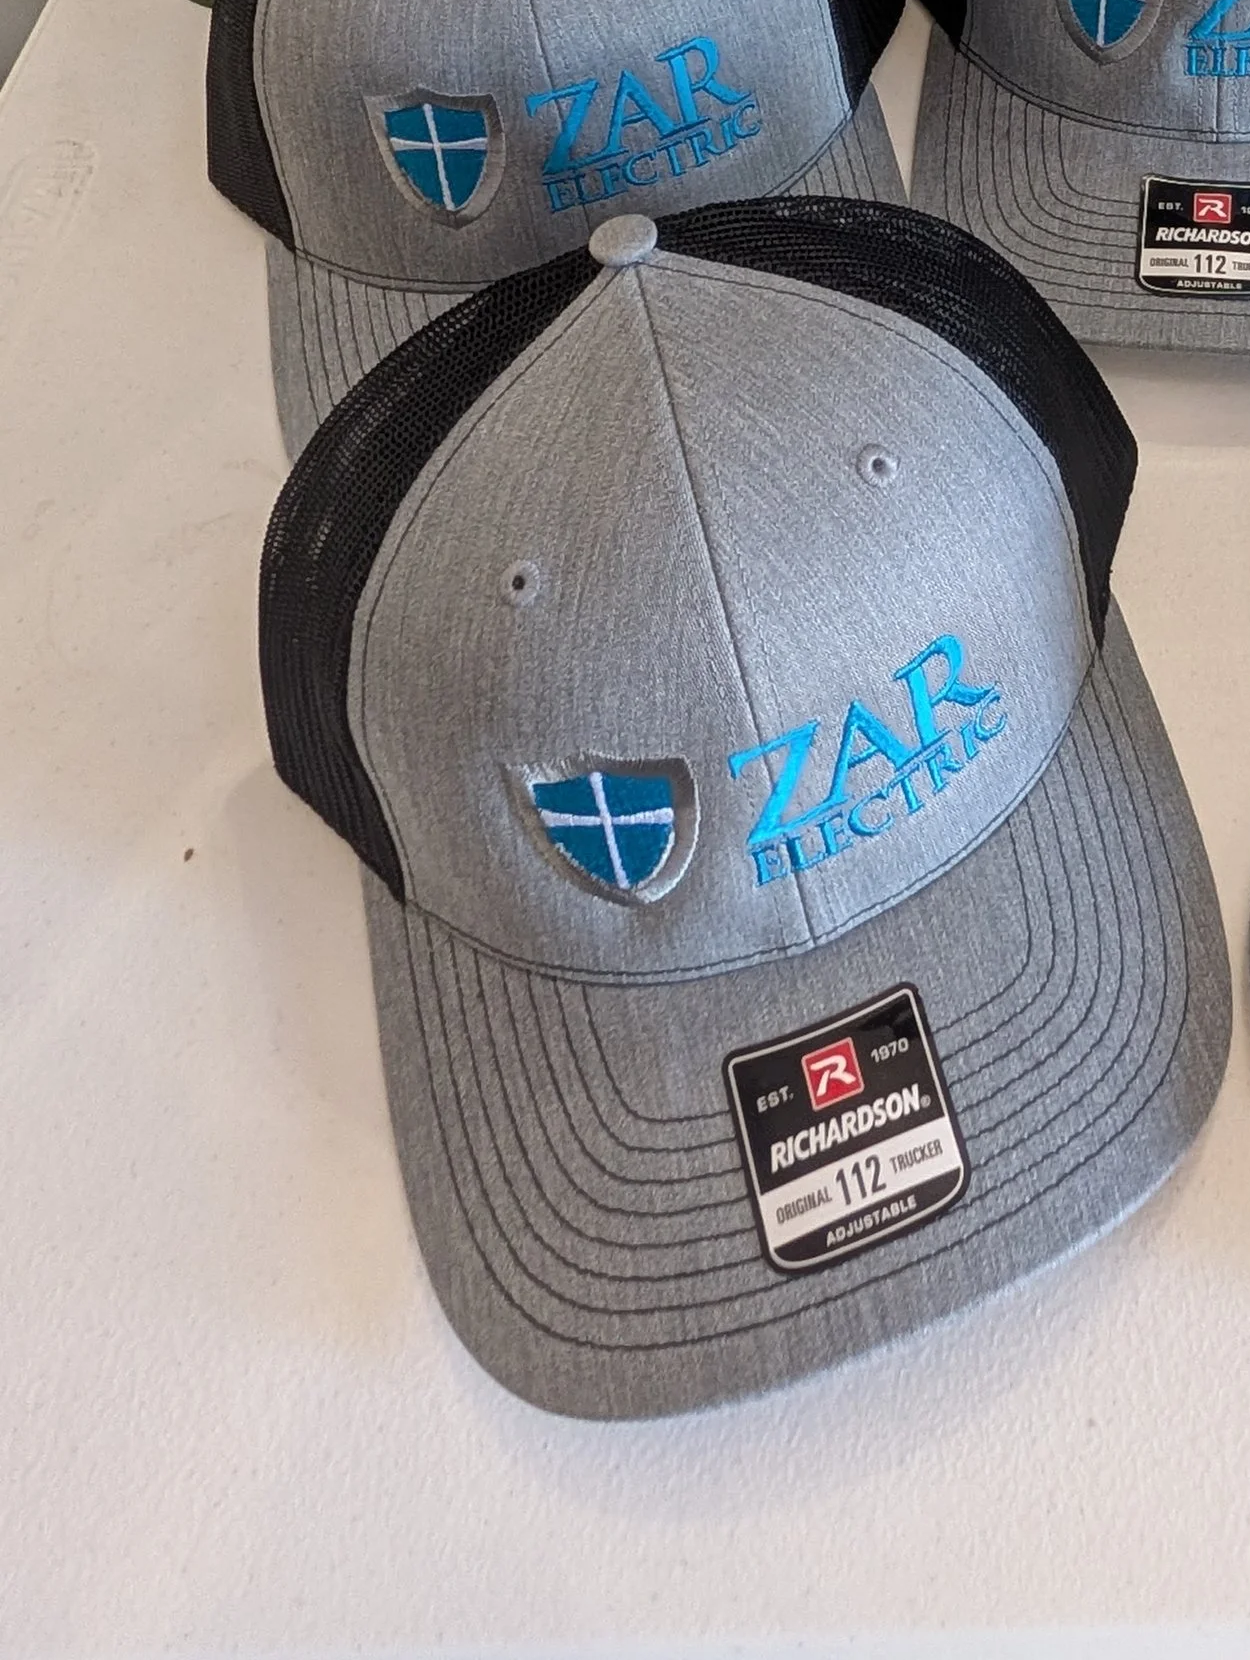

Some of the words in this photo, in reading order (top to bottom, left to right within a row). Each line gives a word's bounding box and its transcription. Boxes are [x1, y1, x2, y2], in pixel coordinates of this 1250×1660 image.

[525, 36, 752, 177] ZAR
[541, 103, 762, 214] ELECTRIC
[1157, 201, 1184, 211] EST.
[1149, 256, 1190, 268] ORIGINAL
[1194, 254, 1227, 275] 112
[1176, 279, 1243, 290] ADJUSTABLE
[729, 634, 1000, 847] ZAR
[748, 692, 1008, 886] ELECTRIC
[757, 1085, 795, 1113] EST.
[776, 1185, 833, 1225] ORIGINAL
[835, 1154, 887, 1207] 112
[889, 1139, 944, 1175] TRUCKER
[825, 1194, 918, 1248] ADJUSTABLE
